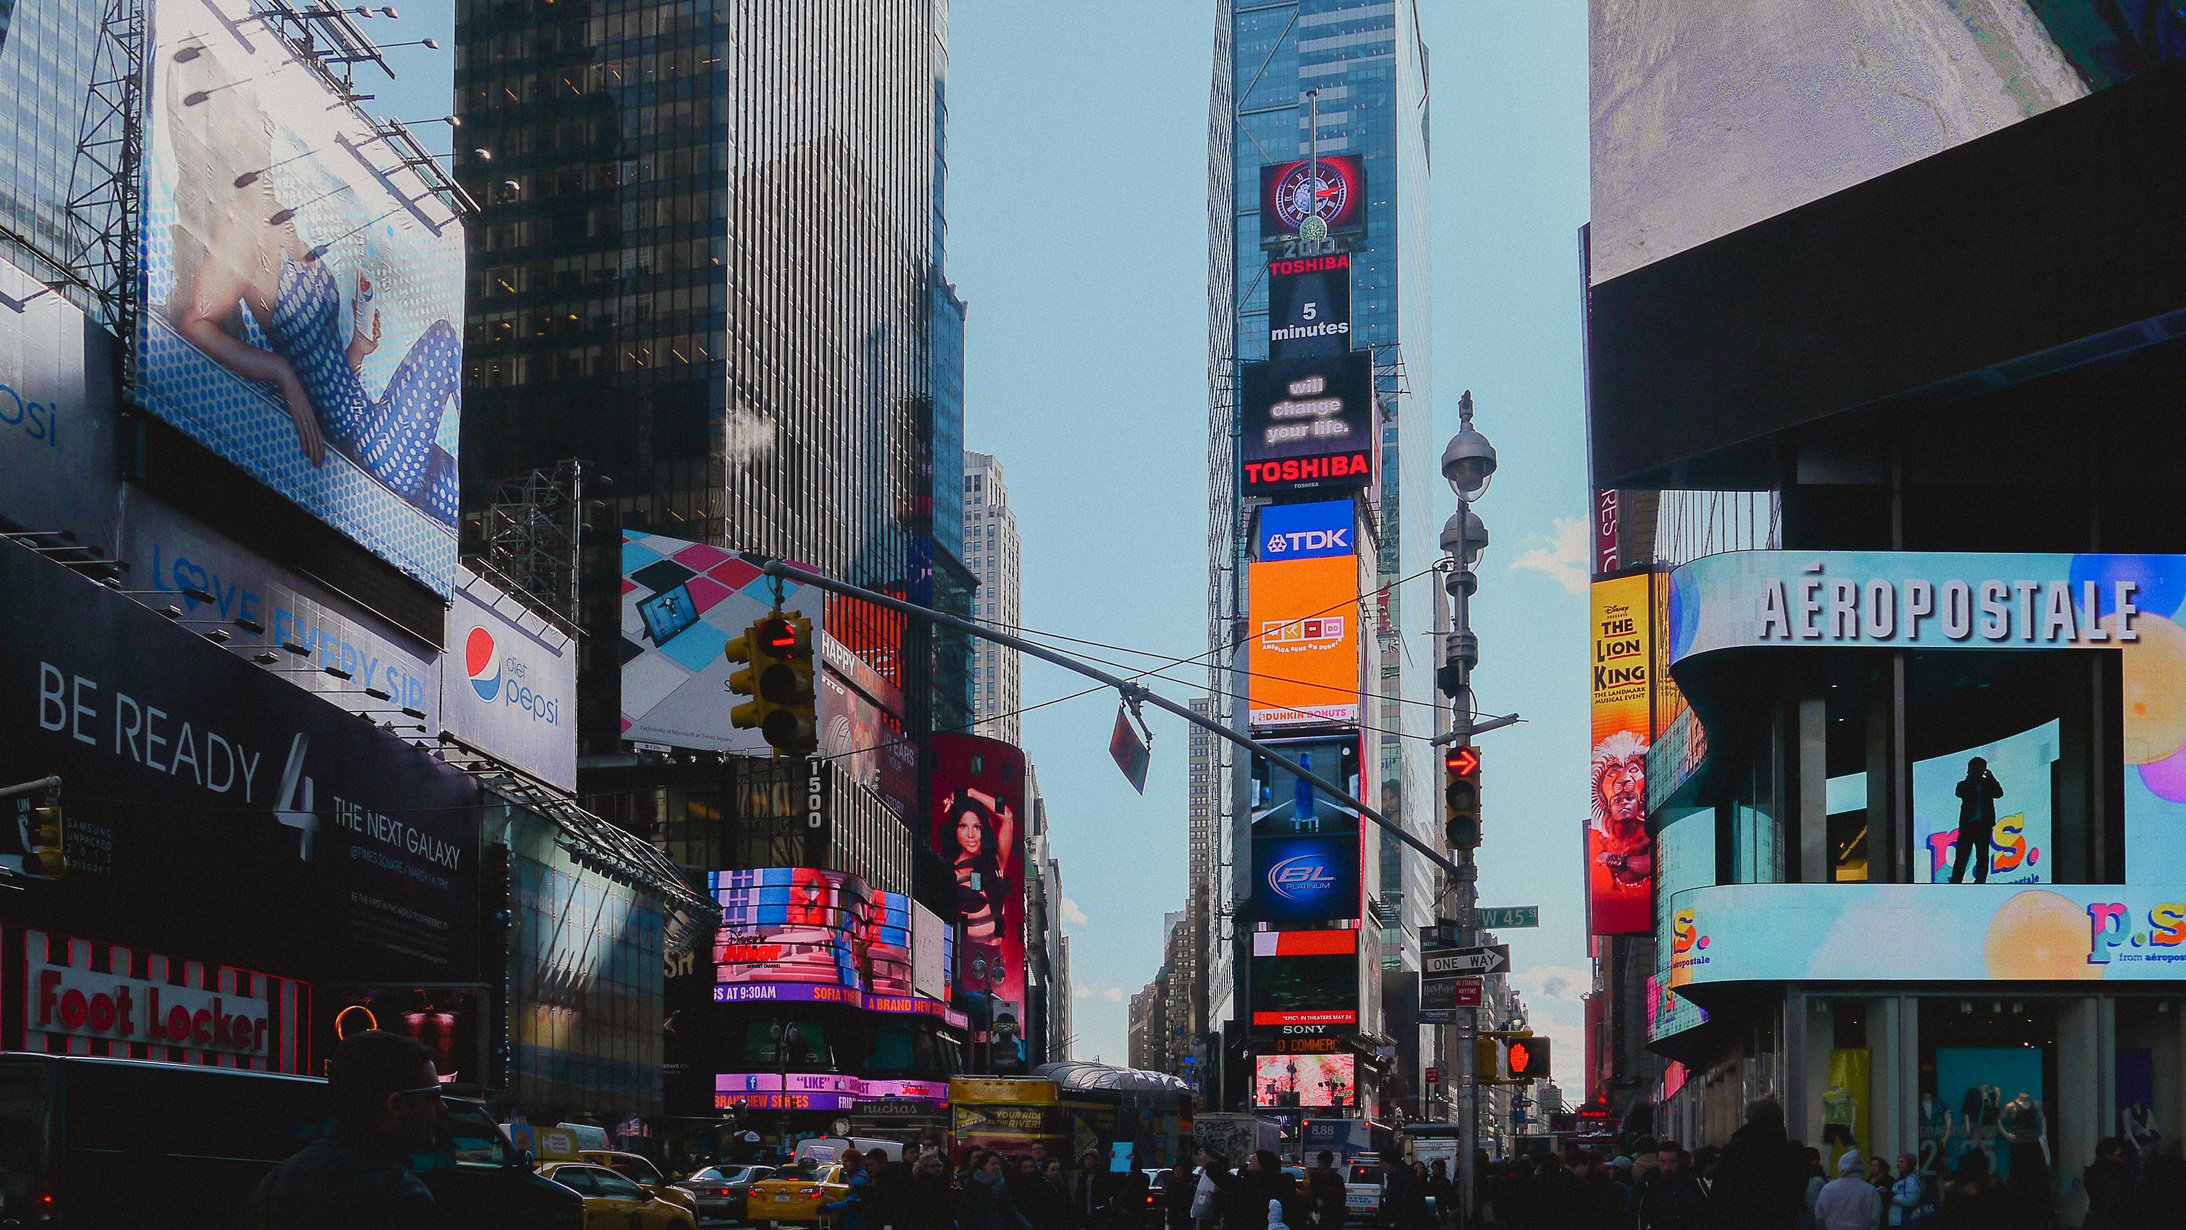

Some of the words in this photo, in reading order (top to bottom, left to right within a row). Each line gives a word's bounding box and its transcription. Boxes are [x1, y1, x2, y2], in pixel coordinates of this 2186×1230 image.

[1270, 255, 1349, 276] TOSHIBA
[1302, 303, 1316, 320] 5
[1271, 321, 1349, 341] minutes
[1289, 378, 1324, 395] will
[1272, 399, 1341, 417] change
[1267, 424, 1309, 443] your
[1314, 420, 1349, 436] life.
[1244, 454, 1368, 484] TOSHIBA
[1294, 481, 1320, 489] TOSHIBA
[1285, 528, 1348, 551] TDK
[1759, 562, 2140, 641] AÉROPOSTALE
[1601, 618, 1634, 635] THE
[822, 633, 855, 676] HAPPY
[1262, 643, 1290, 653] AMERICA
[1596, 639, 1640, 662] LION
[274, 608, 379, 686] EVERY
[386, 666, 425, 709] SIP
[506, 656, 527, 680] diet
[1594, 665, 1645, 692] KING
[1594, 696, 1623, 704] MUSICAL
[1624, 693, 1645, 701] EVENT
[1608, 687, 1646, 697] LANDMARK
[506, 678, 559, 727] pepsi
[1306, 708, 1347, 718] DONUTS
[39, 661, 98, 746] BE
[115, 691, 261, 804] READY
[808, 760, 822, 829] 1500
[67, 817, 112, 841] SAMSUNG
[333, 795, 363, 833] THE
[367, 809, 404, 847] NEXT
[406, 826, 461, 871] GALAXY
[67, 830, 112, 851] UNPACKED
[1277, 866, 1335, 883] BL
[1286, 882, 1330, 890] PLATINUM
[1481, 911, 1497, 926] W
[1503, 909, 1524, 926] 45
[1434, 957, 1459, 971] ONE
[1469, 954, 1496, 967] WAY
[2119, 953, 2143, 961] from
[726, 987, 738, 1000] AT
[740, 986, 776, 999] 9:30AM
[813, 986, 841, 1000] SOFIA
[37, 968, 134, 1036] Foot
[148, 986, 268, 1052] Locker
[869, 1000, 874, 1009] A
[877, 999, 911, 1011] BRAND
[914, 1001, 931, 1013] NEW
[1283, 1025, 1326, 1034] SONY
[863, 1102, 918, 1114] nuchas
[996, 1111, 1021, 1119] YOUR
[1009, 1119, 1041, 1128] RIVER!
[1311, 1125, 1335, 1136] 8.88
